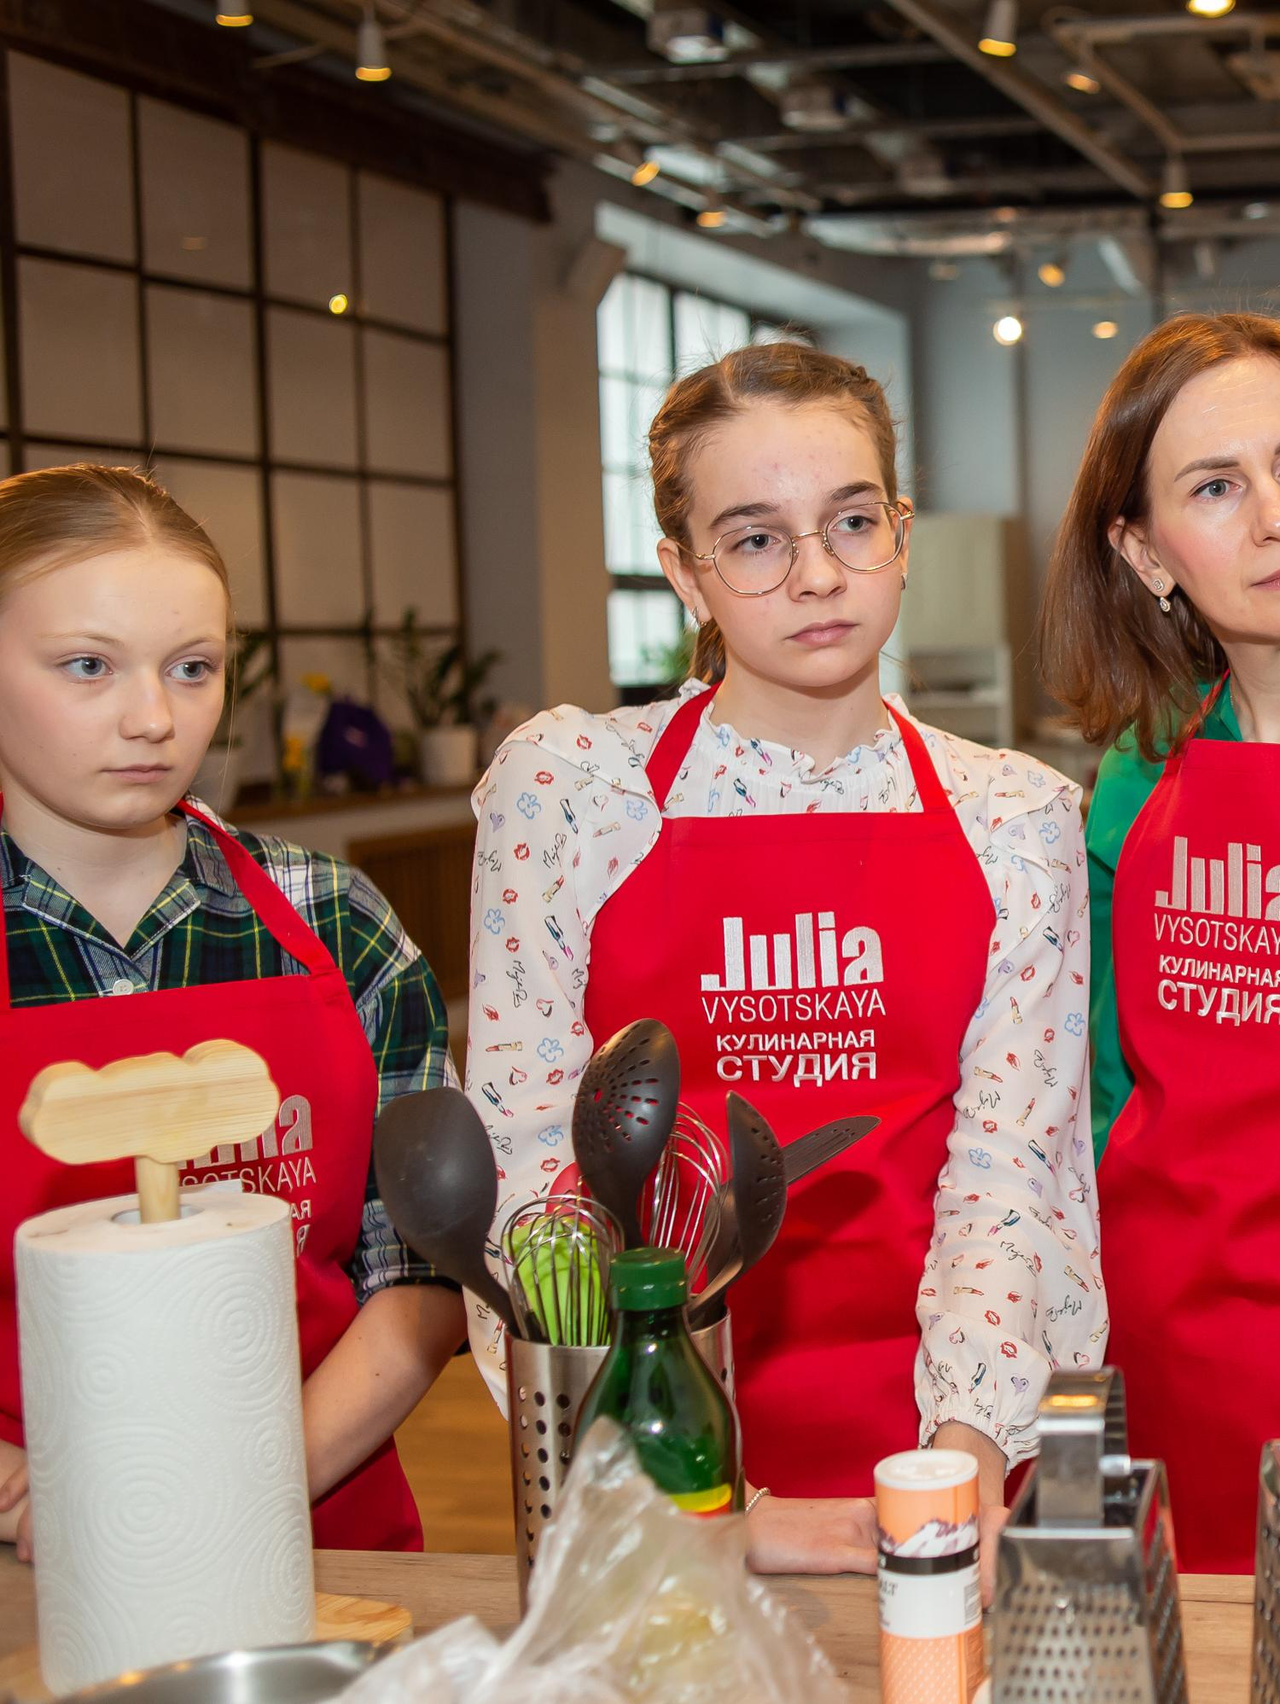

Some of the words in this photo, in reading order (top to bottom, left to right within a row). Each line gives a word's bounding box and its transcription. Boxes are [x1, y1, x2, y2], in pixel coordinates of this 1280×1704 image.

[701, 911, 885, 991] Julia
[701, 988, 886, 1024] VYSOTSKAYA
[716, 1029, 875, 1052] КУЛИНАРНАЯ
[716, 1052, 877, 1088] СТУДИЯ
